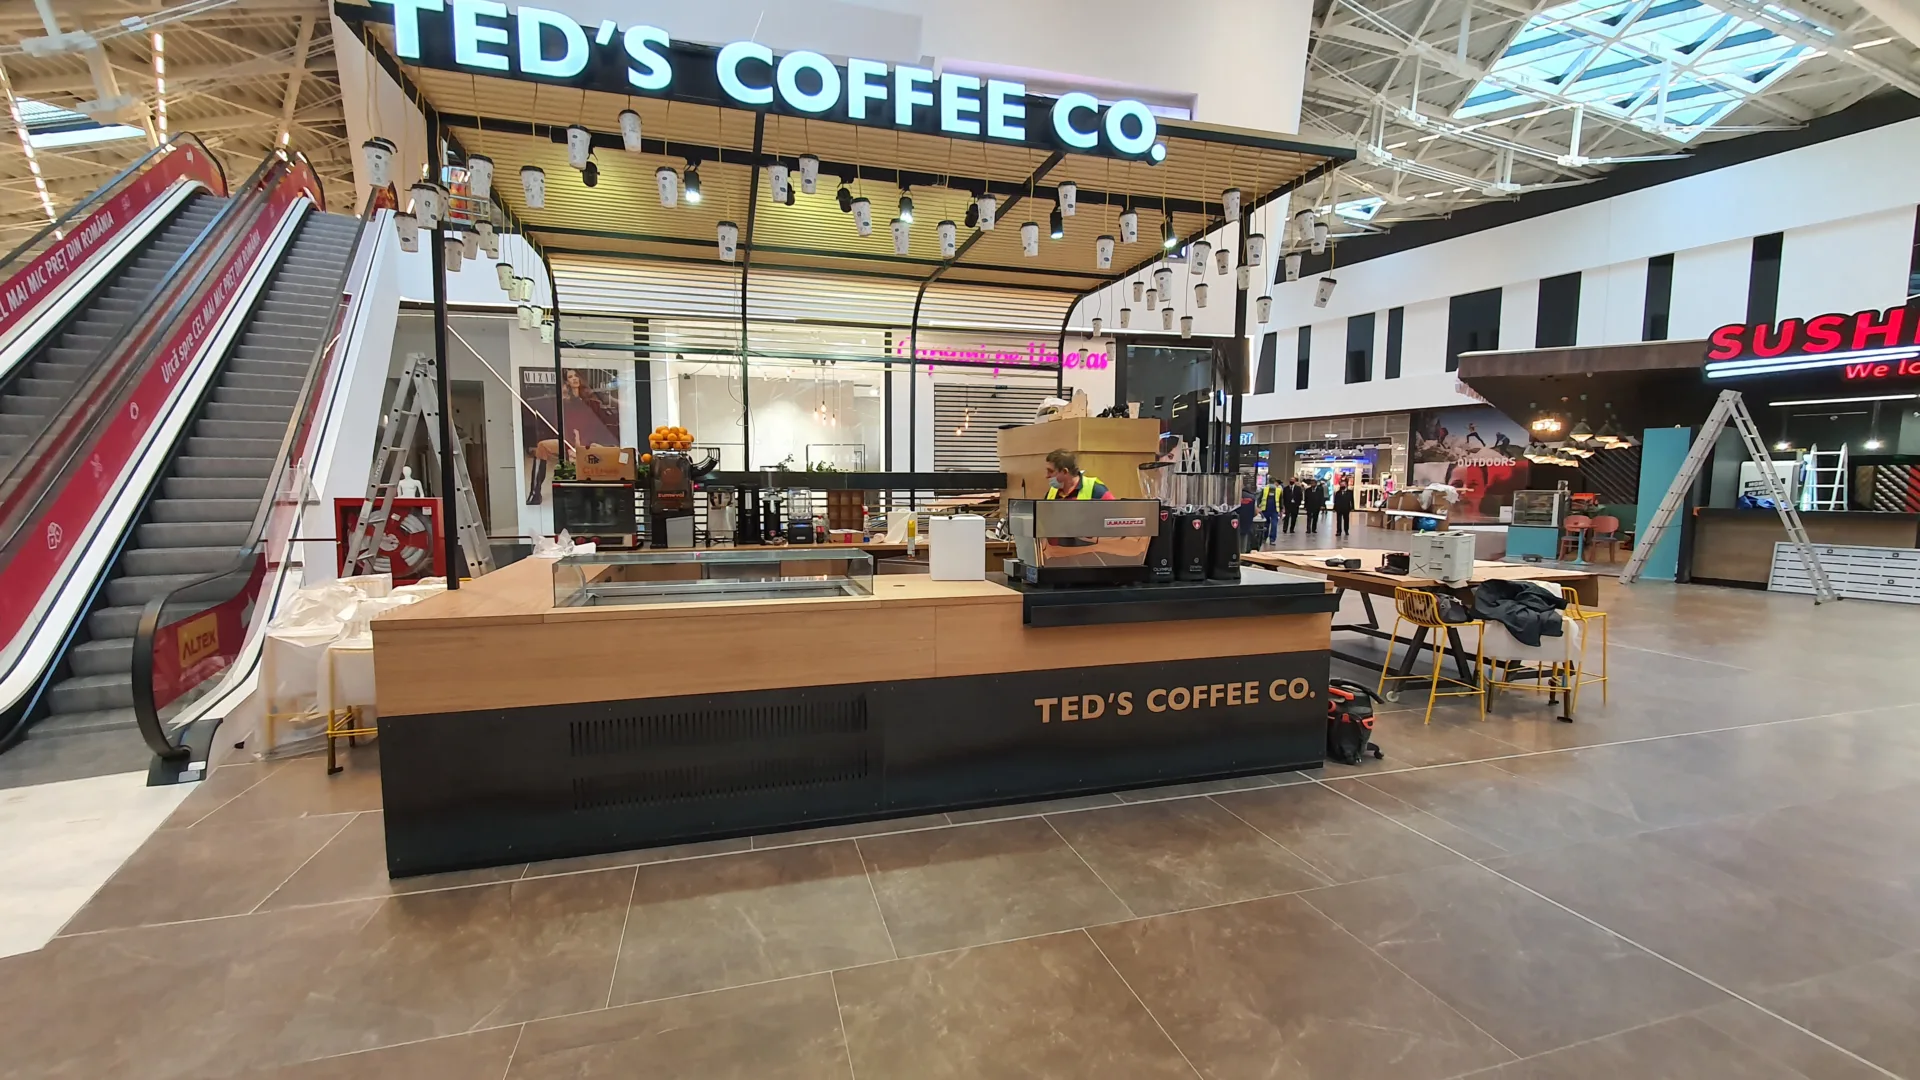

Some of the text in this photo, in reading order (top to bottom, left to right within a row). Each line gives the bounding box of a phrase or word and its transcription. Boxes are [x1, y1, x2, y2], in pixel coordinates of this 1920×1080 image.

[369, 0, 1167, 162] TED'S COFFEE CO.
[6, 281, 29, 311] MAI
[27, 265, 48, 295] MIC
[66, 239, 82, 263] DIN
[178, 332, 194, 361] spre
[191, 314, 205, 340] CEL
[1708, 308, 1920, 360] SUSH
[1846, 363, 1890, 379] We
[1457, 457, 1516, 467] OUTDOORS
[183, 629, 216, 660] ALTEX
[1034, 677, 1316, 723] TED'S COFFEE CO.
